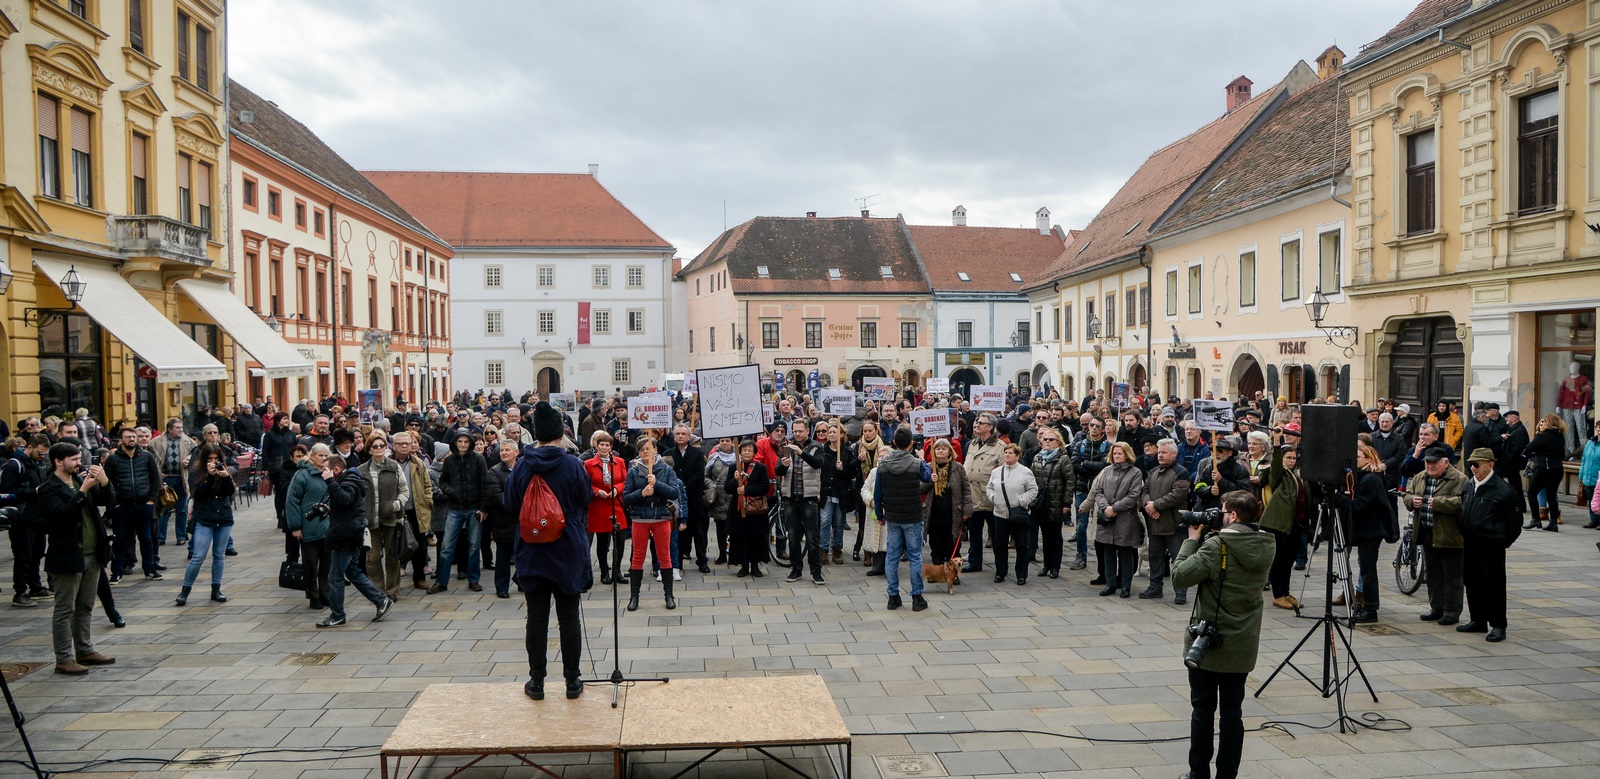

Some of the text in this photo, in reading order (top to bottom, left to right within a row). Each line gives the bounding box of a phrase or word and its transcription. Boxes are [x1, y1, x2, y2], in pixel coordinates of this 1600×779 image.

[1278, 341, 1306, 354] TISAK
[704, 374, 744, 389] NISMO
[720, 386, 732, 397] MI
[706, 397, 740, 410] VAŠI
